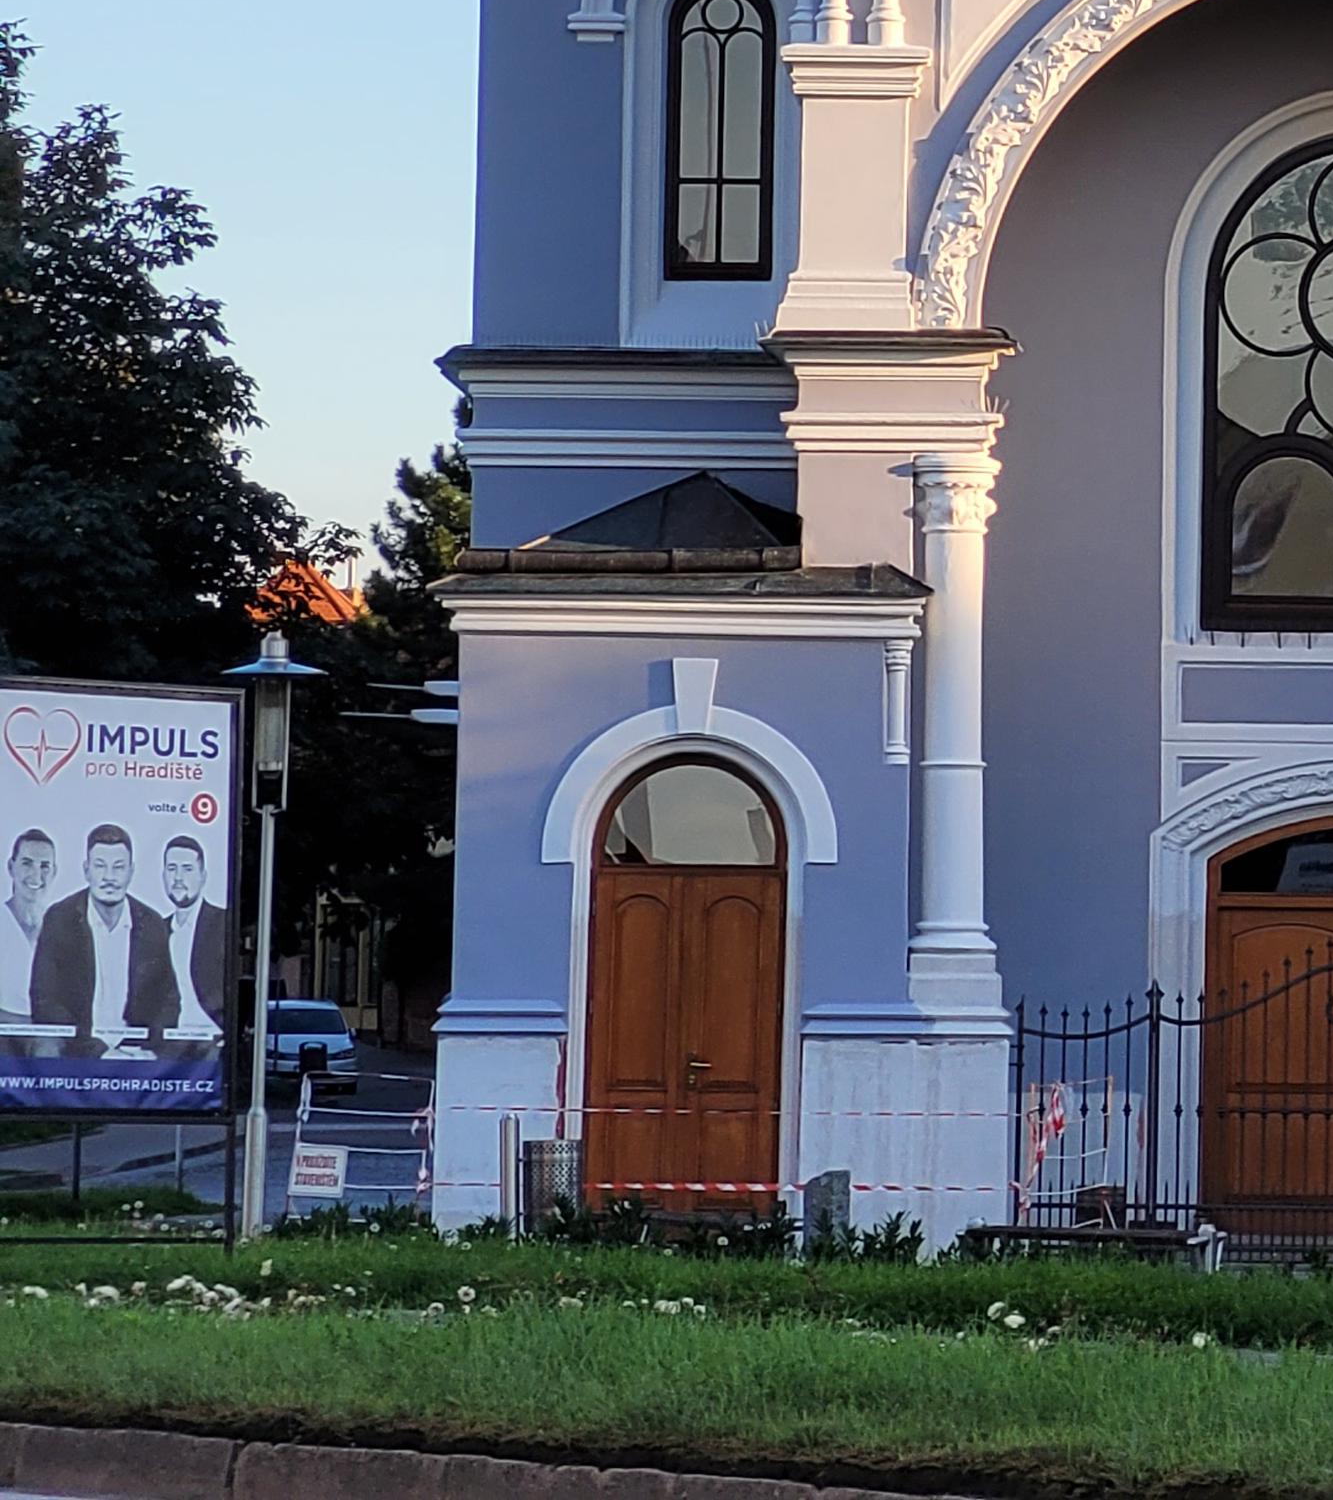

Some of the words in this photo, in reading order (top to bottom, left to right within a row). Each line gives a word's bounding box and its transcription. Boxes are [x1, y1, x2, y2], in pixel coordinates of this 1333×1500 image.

[86, 723, 220, 760] IMPULS
[84, 761, 118, 778] pro
[123, 760, 204, 781] Hradiště
[148, 802, 177, 814] volte
[196, 796, 213, 820] 9
